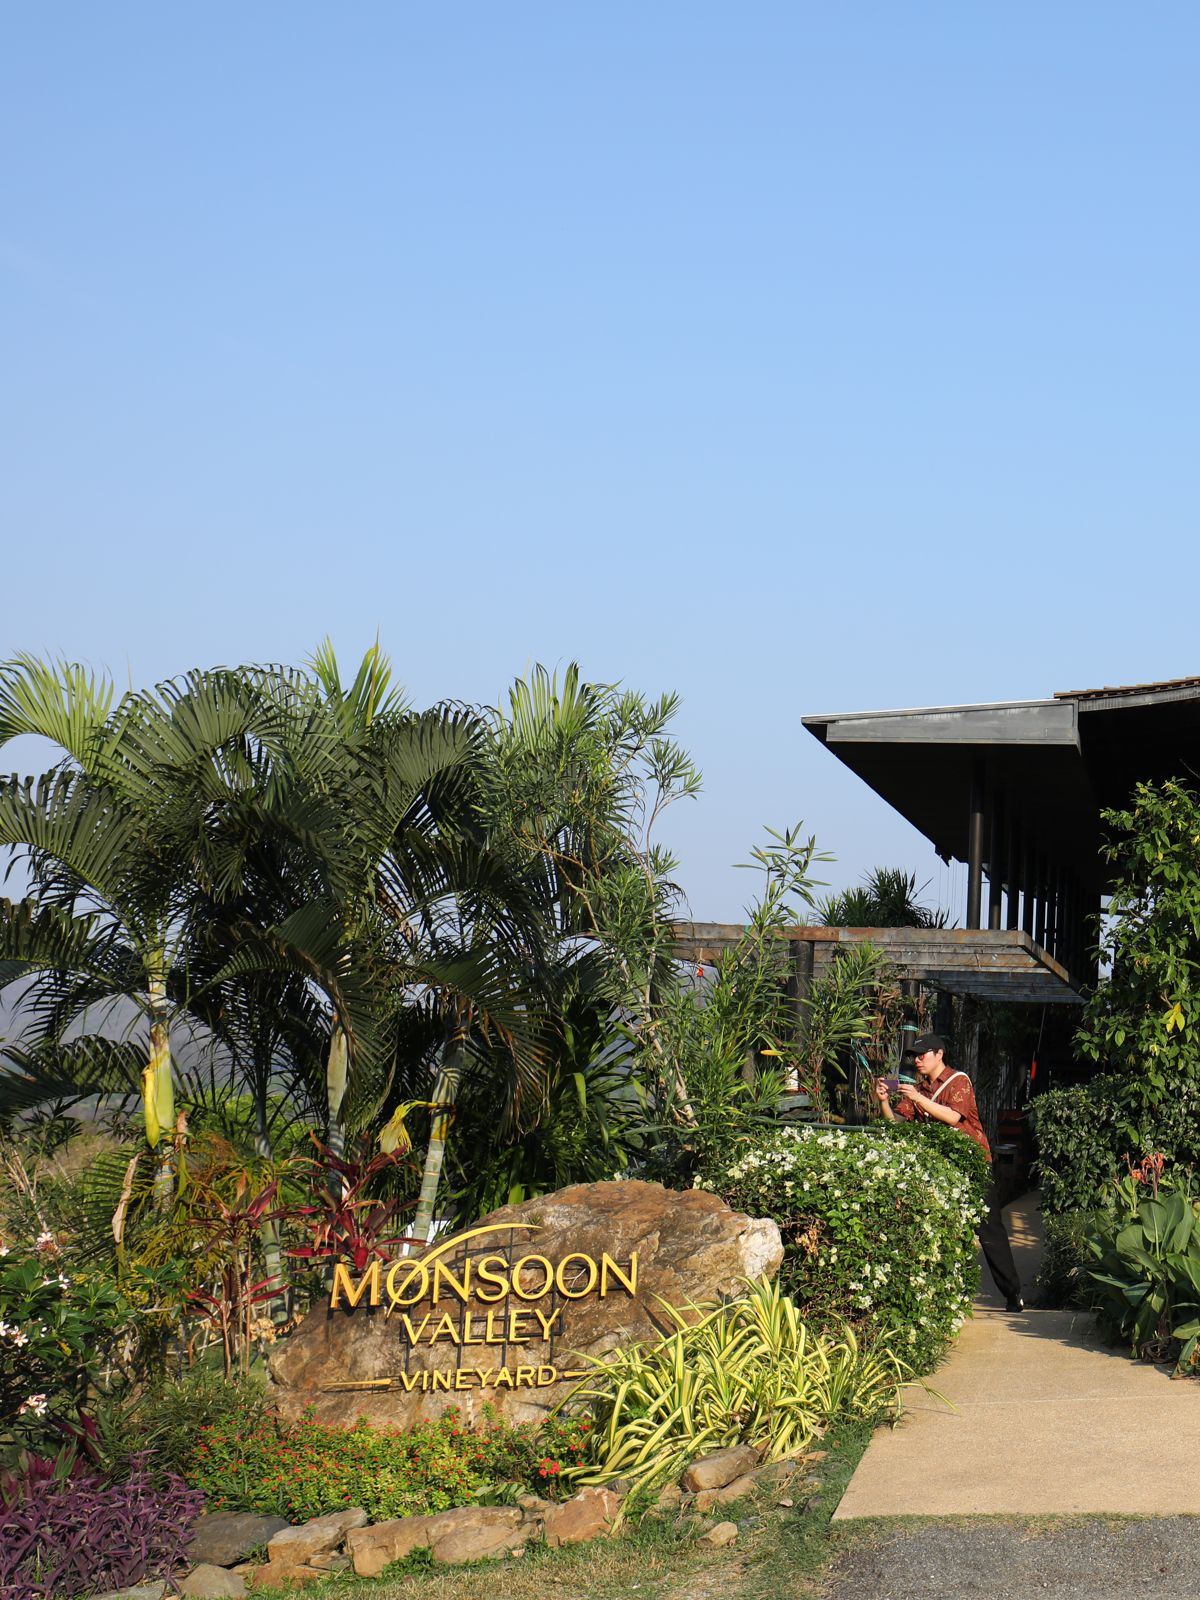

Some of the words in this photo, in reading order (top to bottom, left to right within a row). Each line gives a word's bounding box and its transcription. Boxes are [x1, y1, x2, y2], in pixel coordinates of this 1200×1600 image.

[330, 1250, 639, 1309] MONSOON
[402, 1308, 561, 1346] VALLEY
[400, 1365, 557, 1392] VINEYARD
